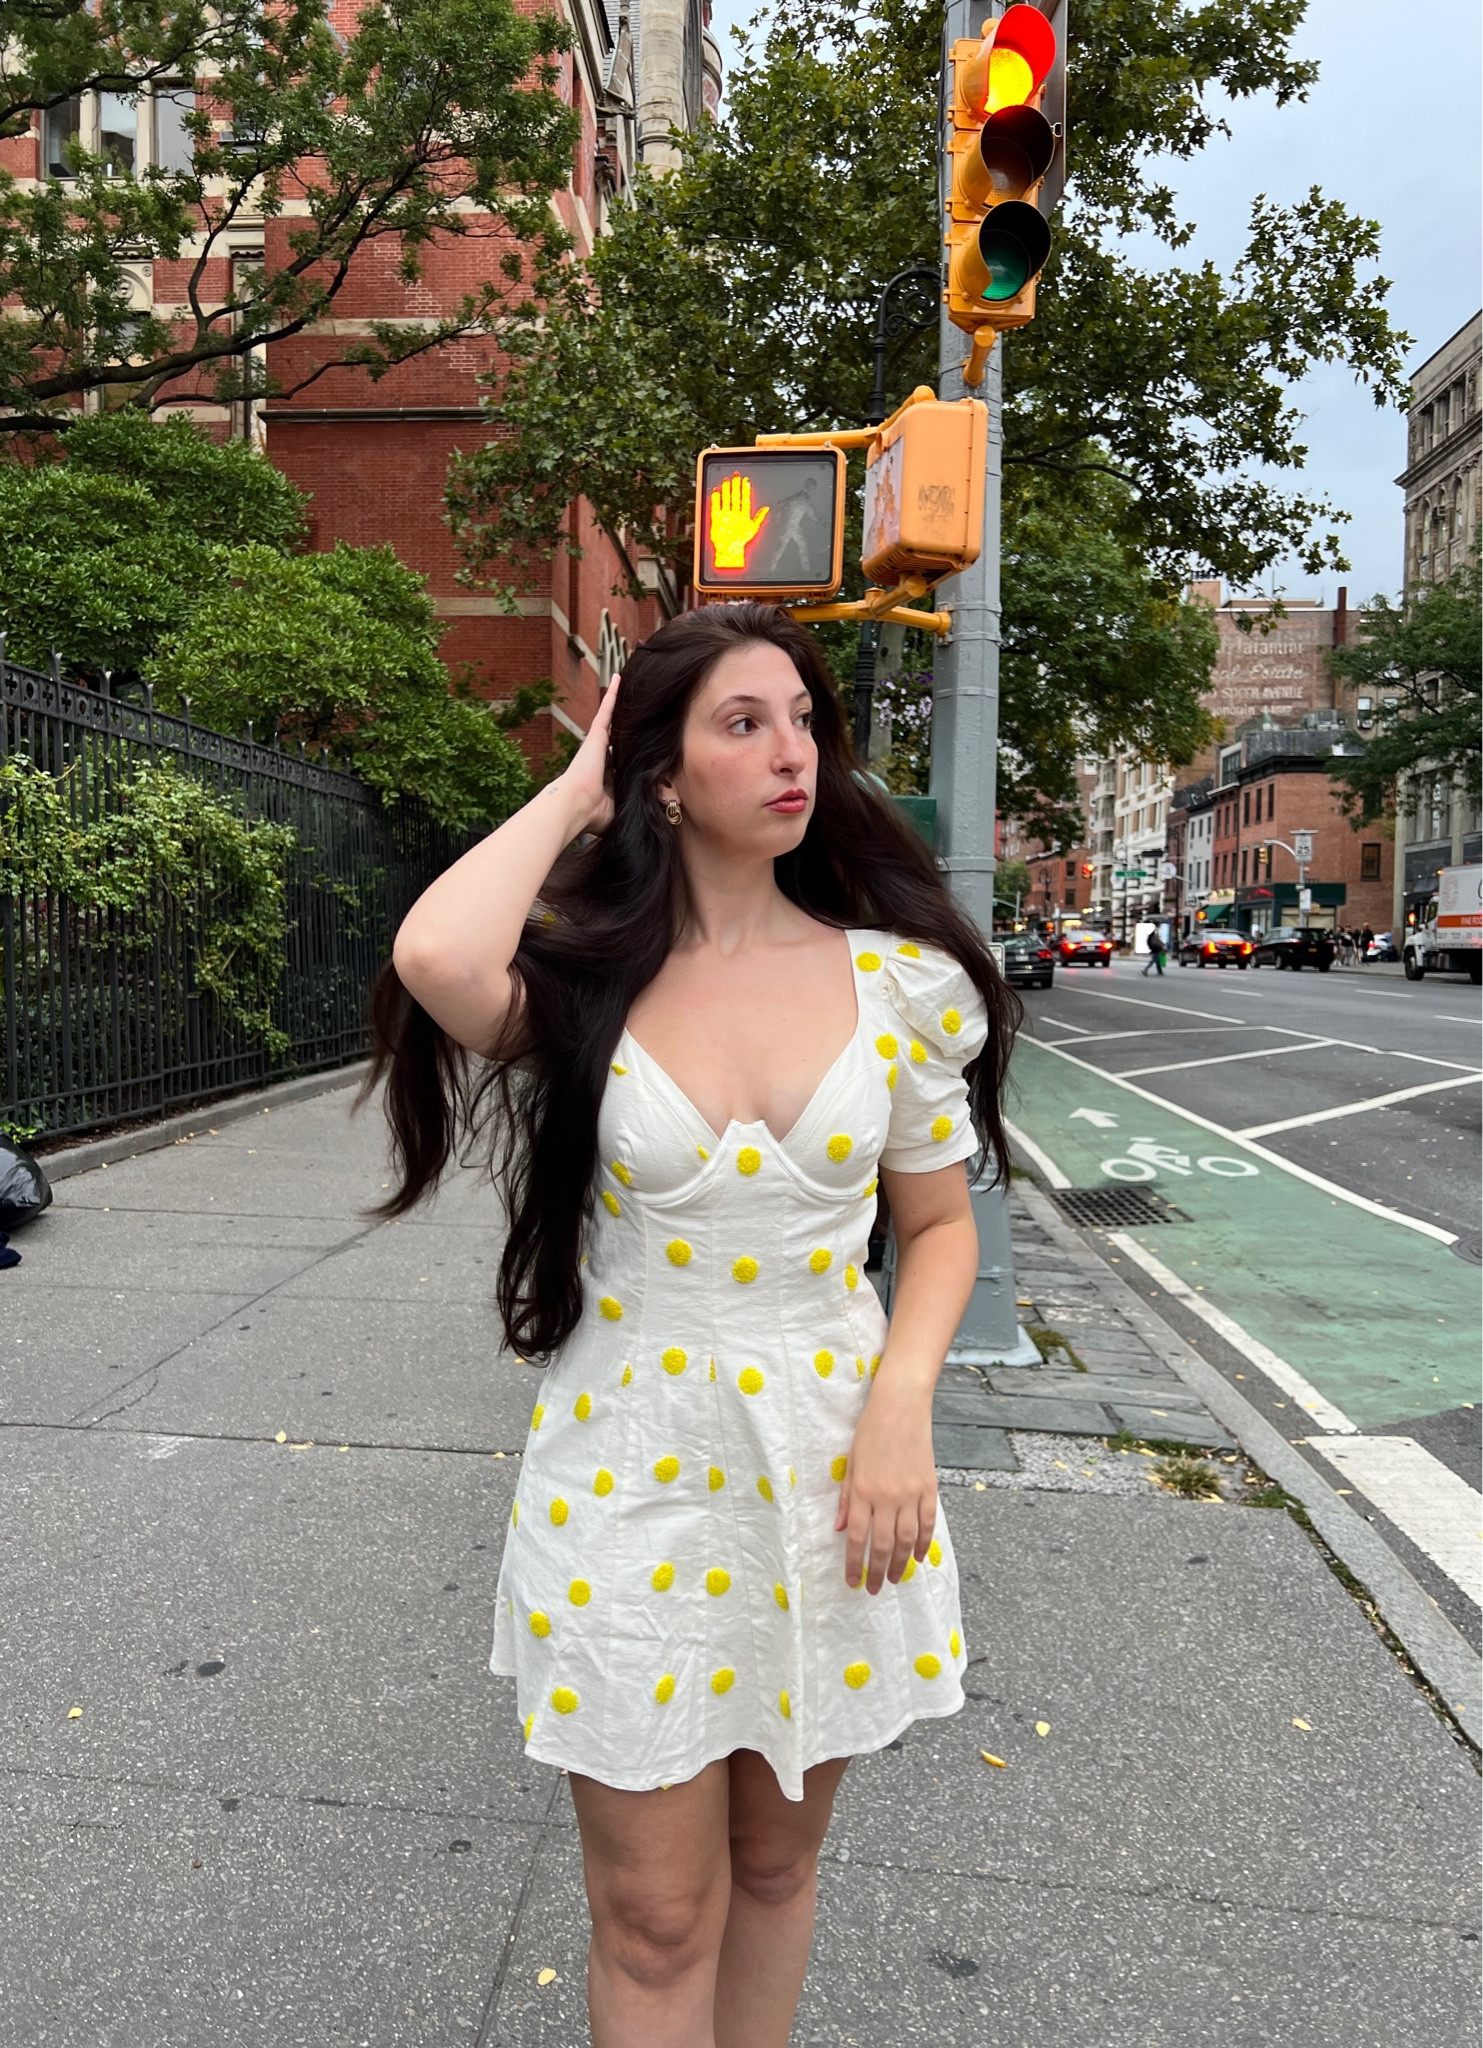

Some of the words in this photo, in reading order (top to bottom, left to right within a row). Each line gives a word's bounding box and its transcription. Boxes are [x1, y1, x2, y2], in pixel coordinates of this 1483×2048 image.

[1220, 687, 1260, 699] SIXTH
[1262, 686, 1304, 699] AVENUE
[1297, 846, 1310, 855] 25
